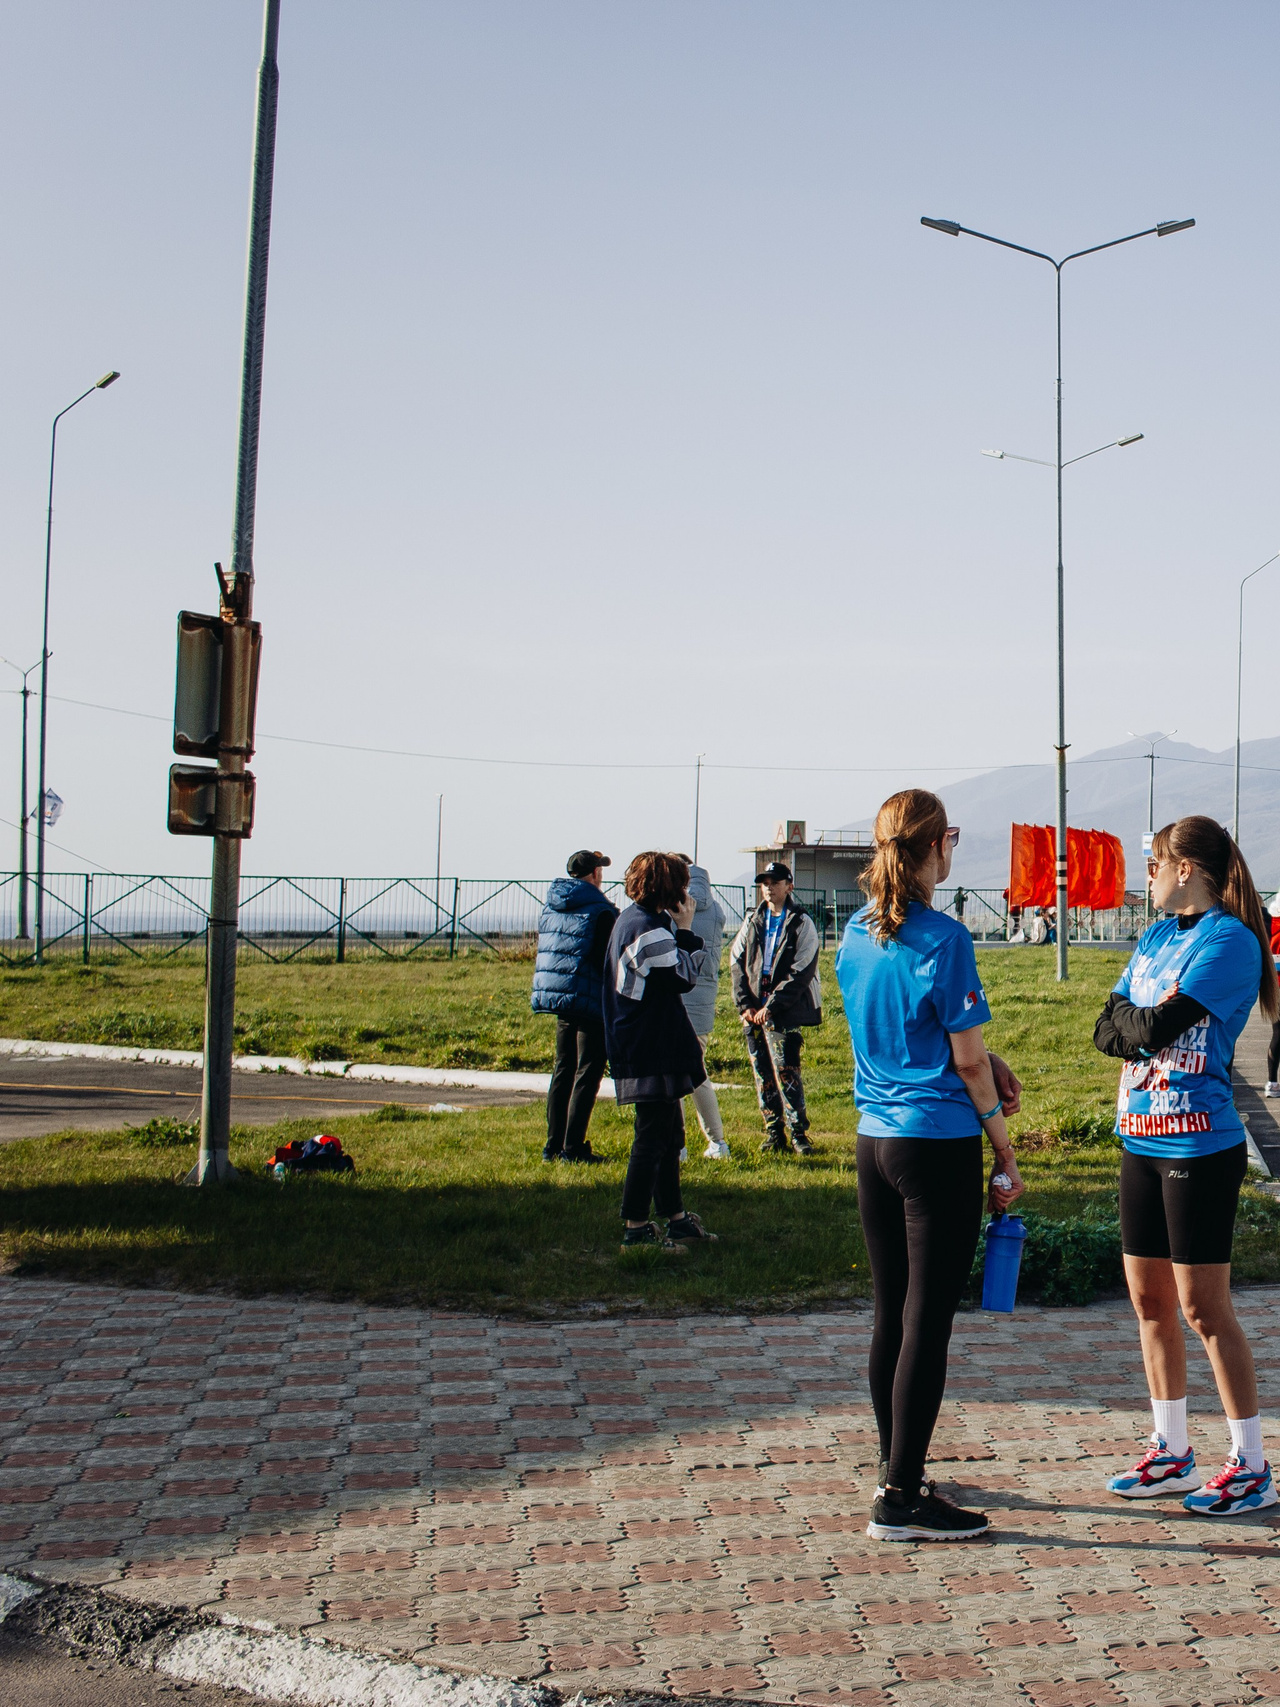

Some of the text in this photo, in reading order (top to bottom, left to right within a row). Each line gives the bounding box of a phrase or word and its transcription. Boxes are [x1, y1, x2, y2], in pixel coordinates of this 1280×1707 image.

[1170, 1026, 1208, 1051] 024
[1149, 1091, 1191, 1114] 2024
[1120, 1111, 1212, 1136] #ЕДИНСТВО
[1168, 1170, 1189, 1178] FILA
